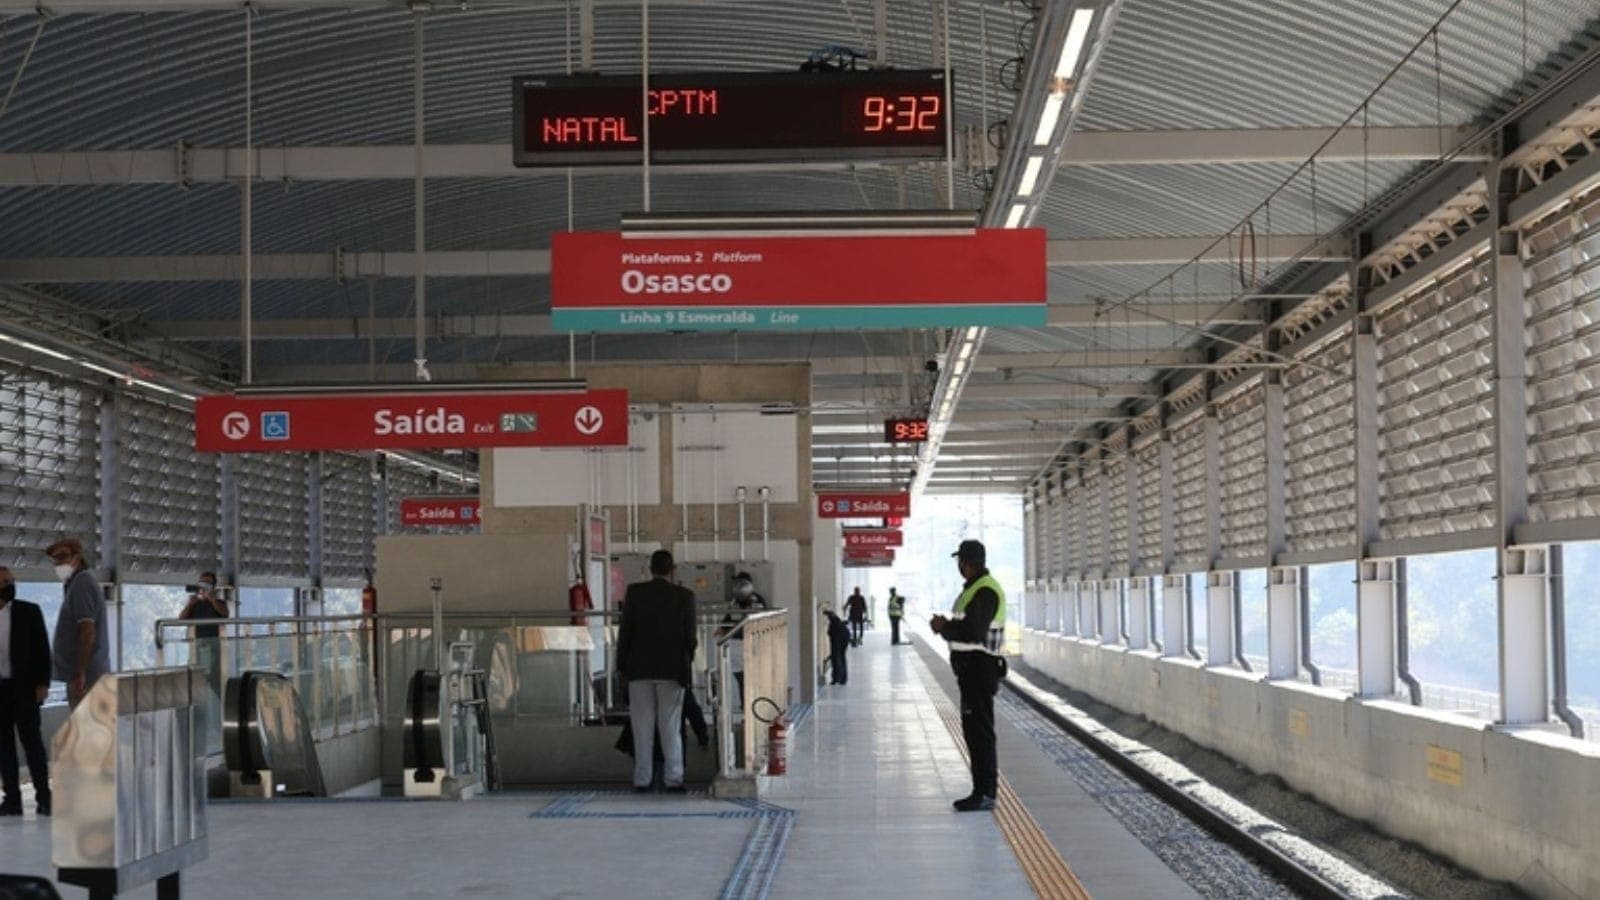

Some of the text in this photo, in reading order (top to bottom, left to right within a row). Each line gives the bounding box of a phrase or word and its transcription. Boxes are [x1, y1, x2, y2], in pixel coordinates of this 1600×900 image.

[648, 90, 717, 115] CPTM
[864, 96, 939, 131] 9:32
[543, 117, 638, 143] NATAL
[621, 251, 763, 264] Plataforma 2 Platform
[620, 269, 733, 294] Osasco
[620, 311, 799, 324] Linha 9 Esmeralda Line
[374, 407, 495, 435] Saída Exit
[895, 421, 928, 439] 9:32
